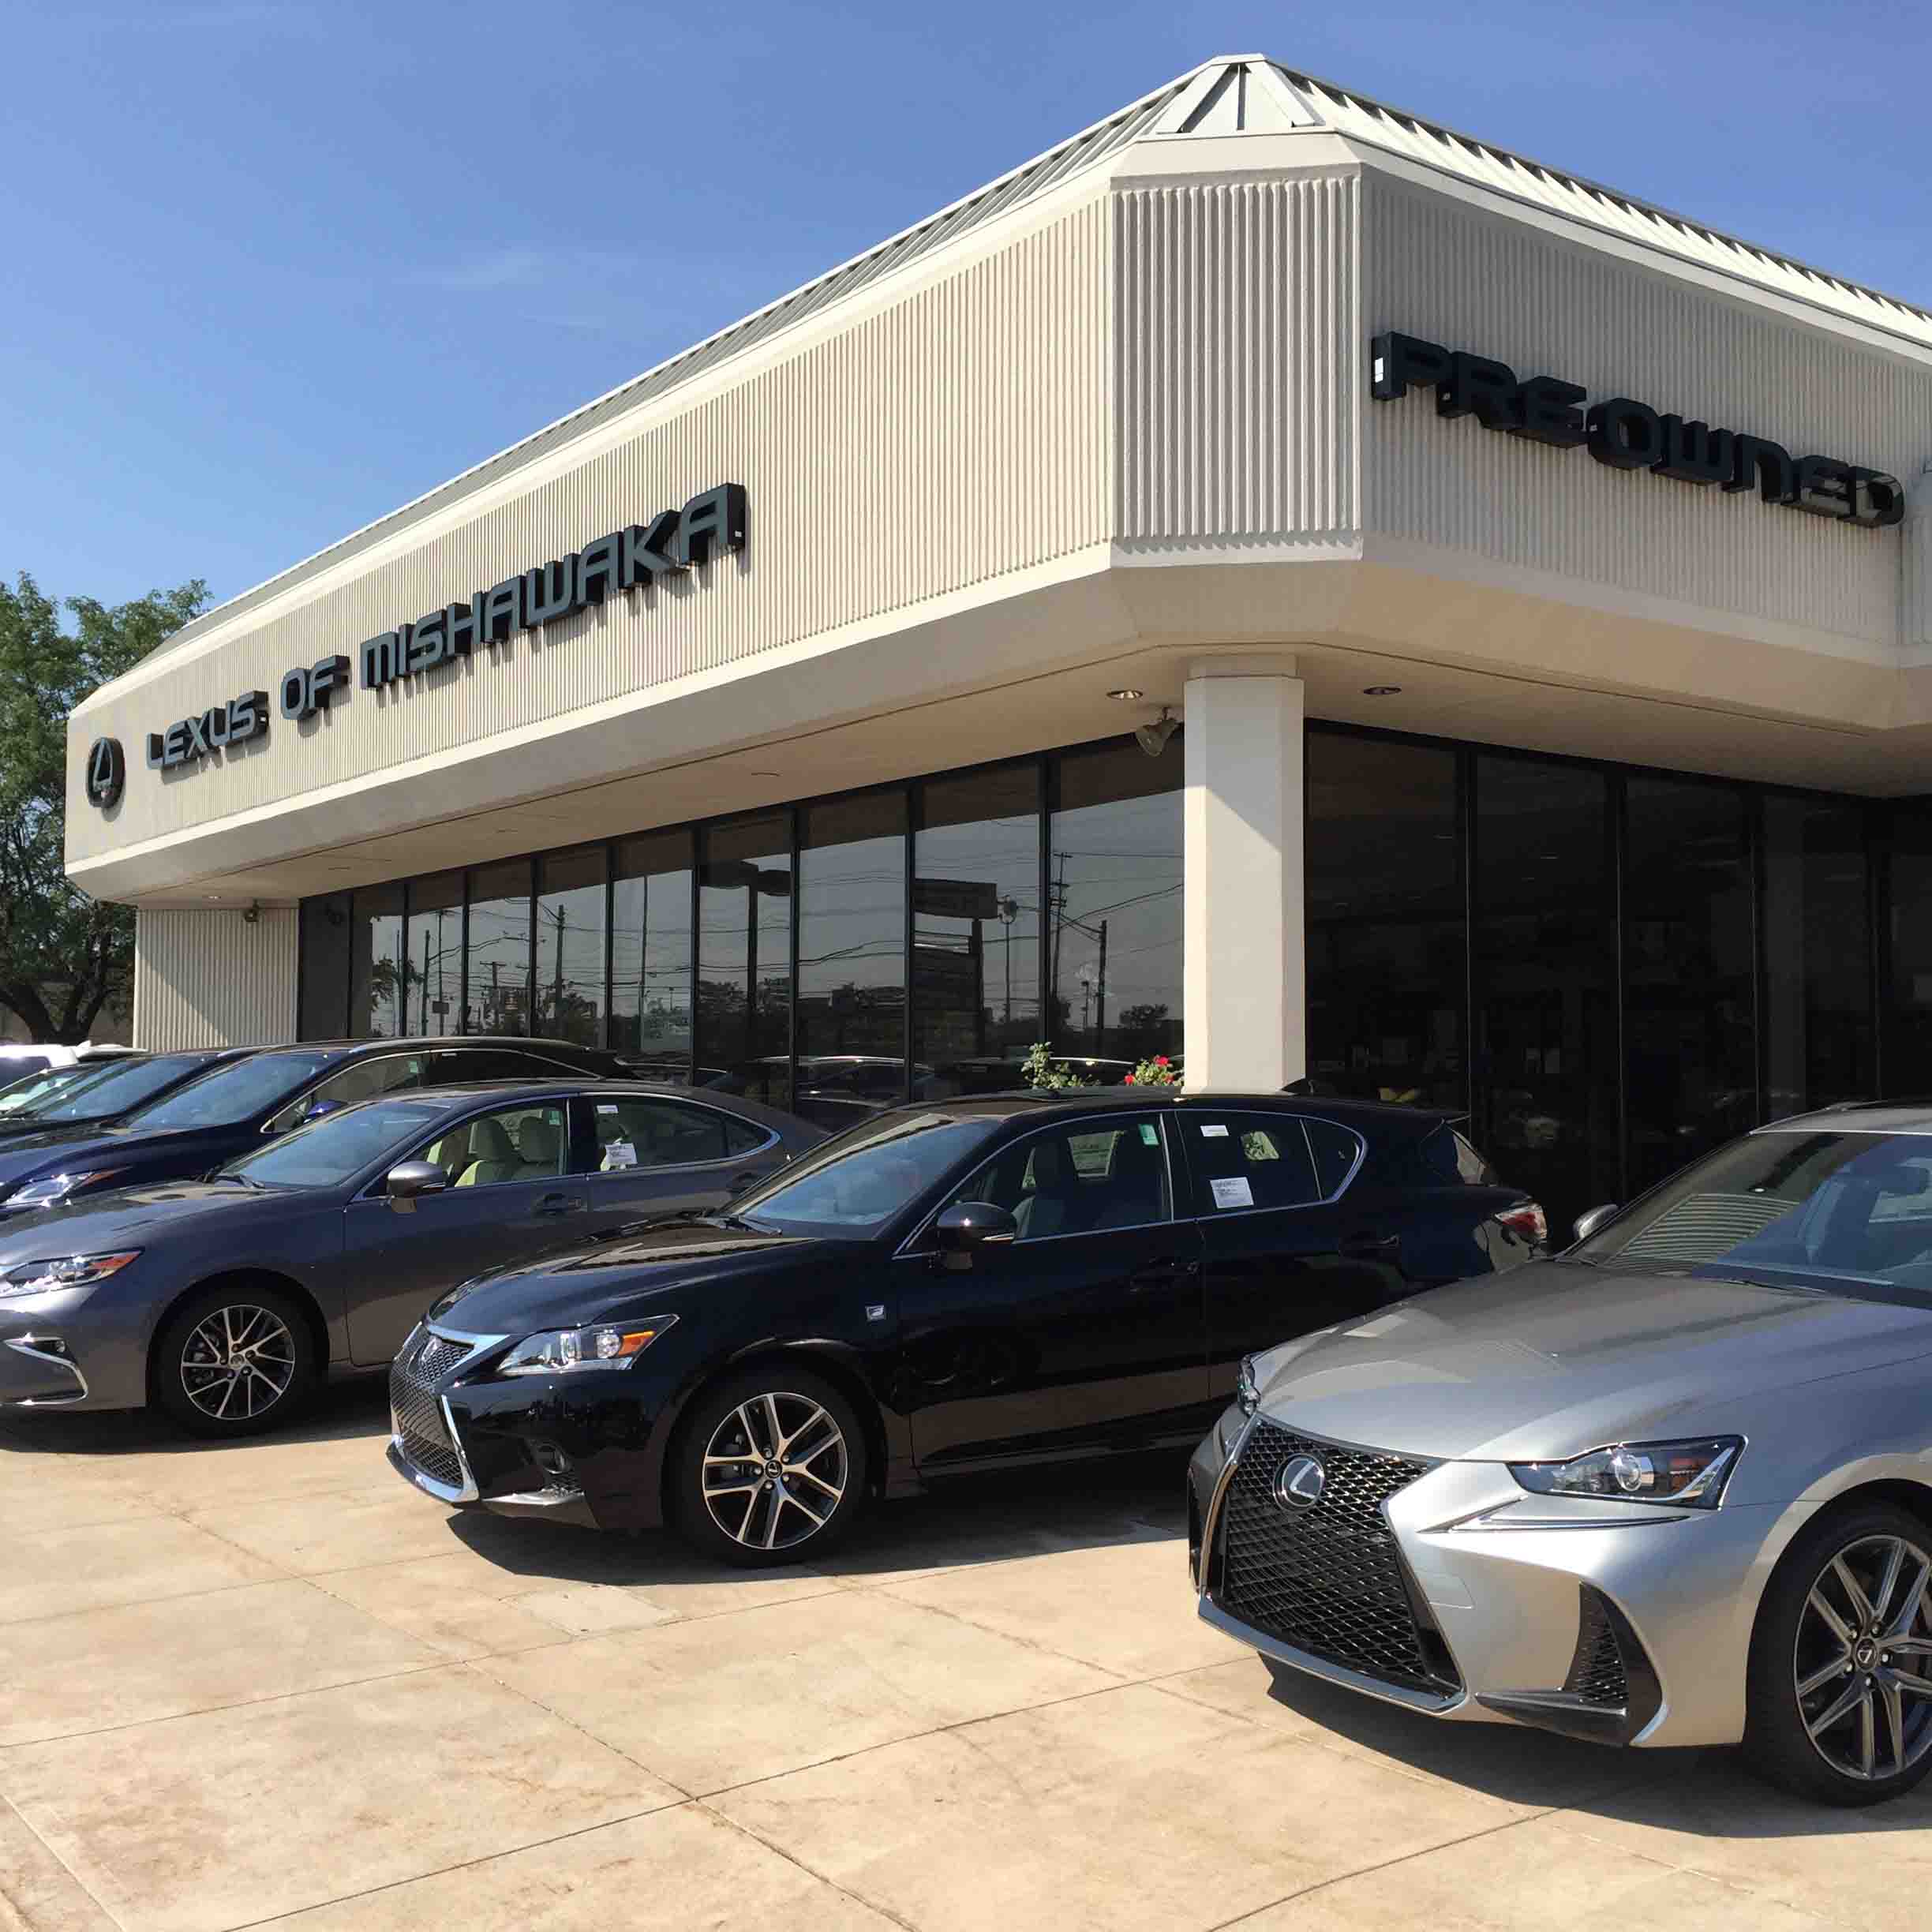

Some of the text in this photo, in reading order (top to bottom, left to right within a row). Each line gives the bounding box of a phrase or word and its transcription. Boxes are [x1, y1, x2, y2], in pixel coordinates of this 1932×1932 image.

[145, 482, 746, 770] LEXUS OF MISHAWAKA
